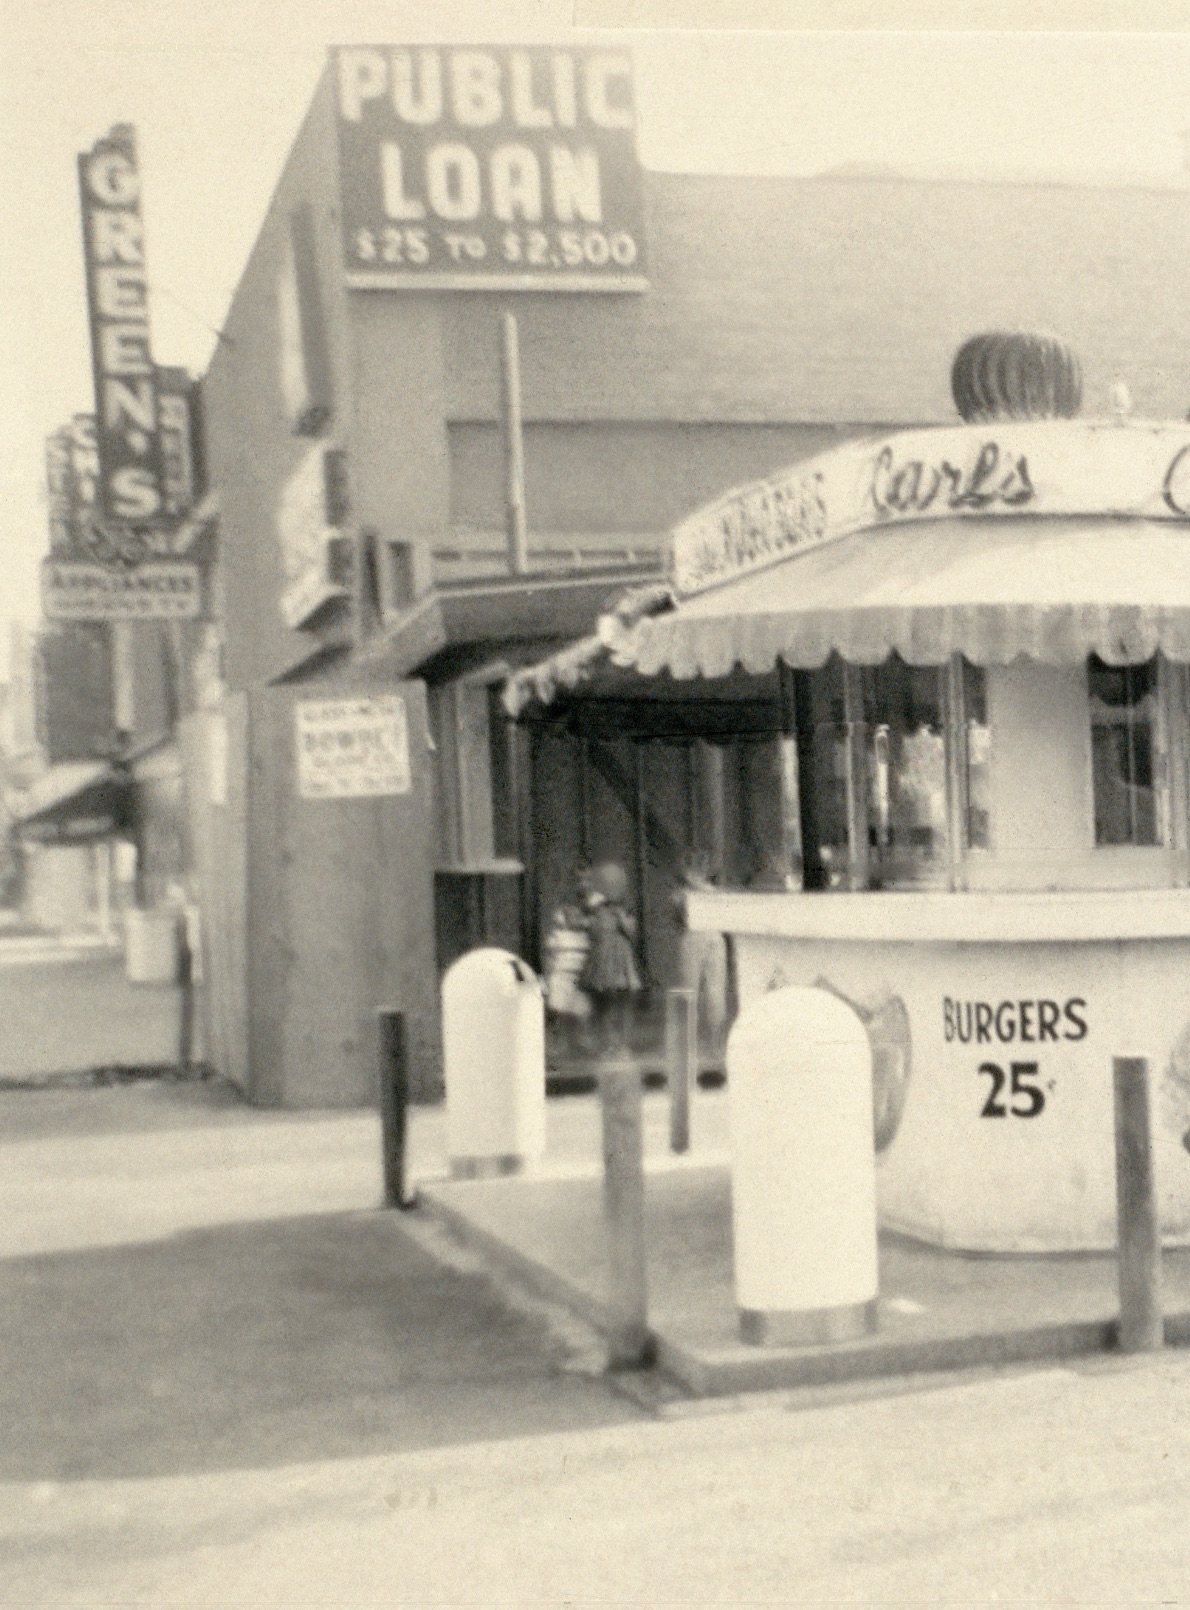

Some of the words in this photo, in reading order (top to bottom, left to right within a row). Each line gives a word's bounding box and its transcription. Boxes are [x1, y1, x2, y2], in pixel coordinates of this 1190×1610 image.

[337, 48, 635, 129] PUBLIC
[380, 140, 602, 222] LOAN
[355, 226, 430, 264] $25
[503, 229, 638, 268] $2,500
[870, 441, 1035, 519] Carl's
[943, 995, 1089, 1045] BURGERS
